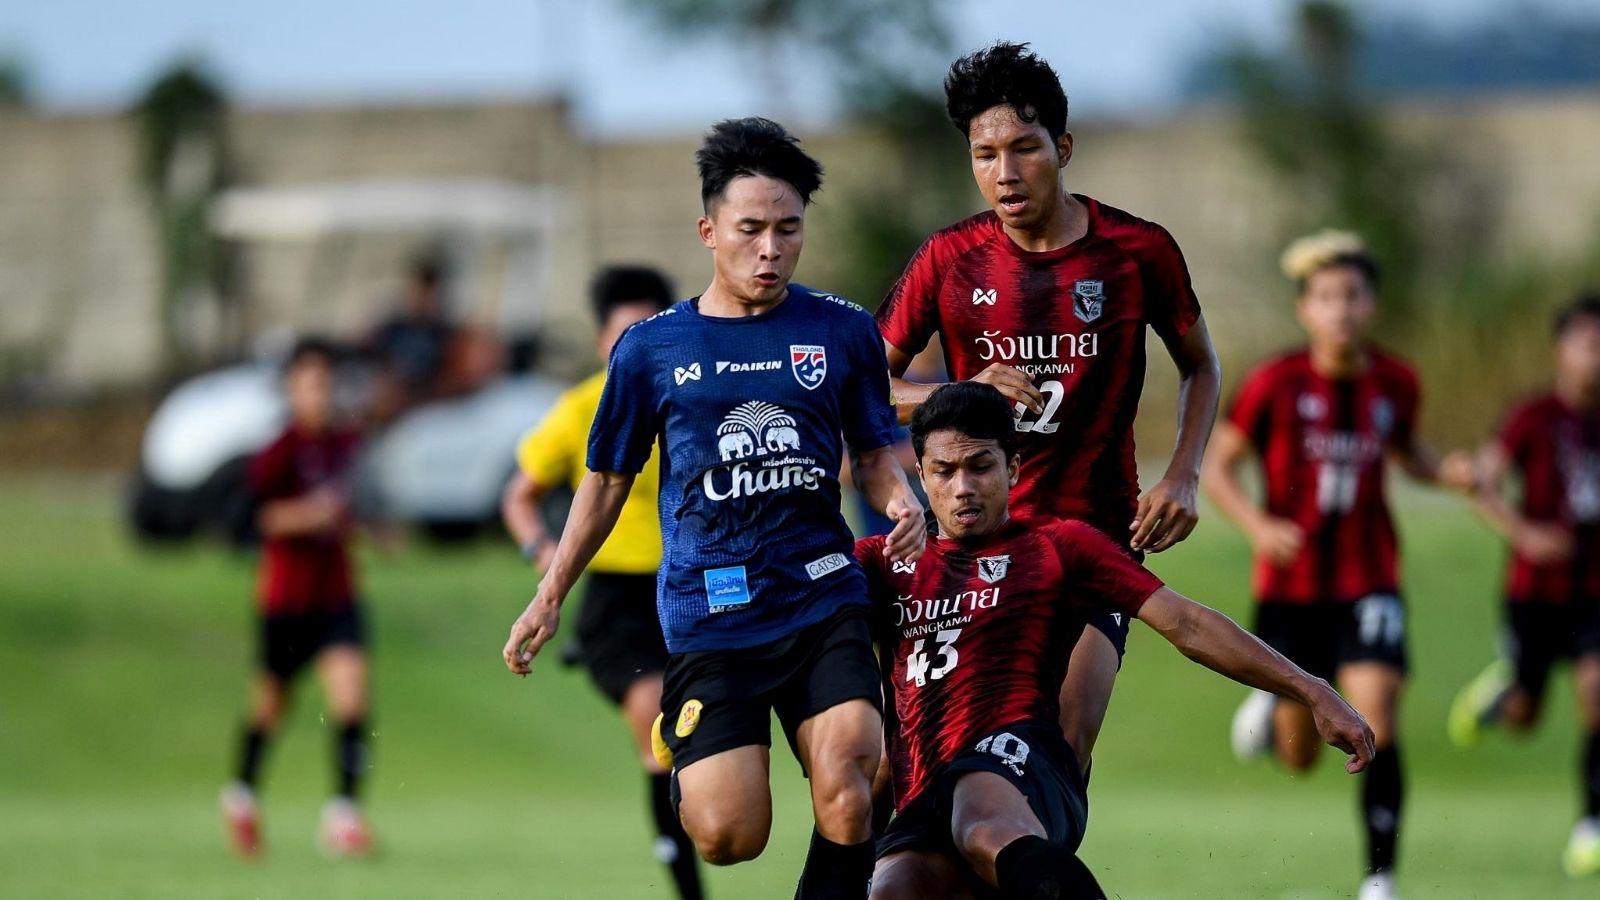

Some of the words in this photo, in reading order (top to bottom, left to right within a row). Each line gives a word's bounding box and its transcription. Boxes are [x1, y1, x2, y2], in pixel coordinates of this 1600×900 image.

[975, 330, 1098, 360] วังขนาย
[730, 360, 782, 372] DAIKIN
[1009, 363, 1075, 375] NGKANAI
[703, 462, 826, 501] Chang
[809, 554, 846, 576] GATSBY
[892, 587, 1000, 627] วังขนาย
[903, 614, 973, 639] WANGKANAI
[906, 628, 963, 688] 43
